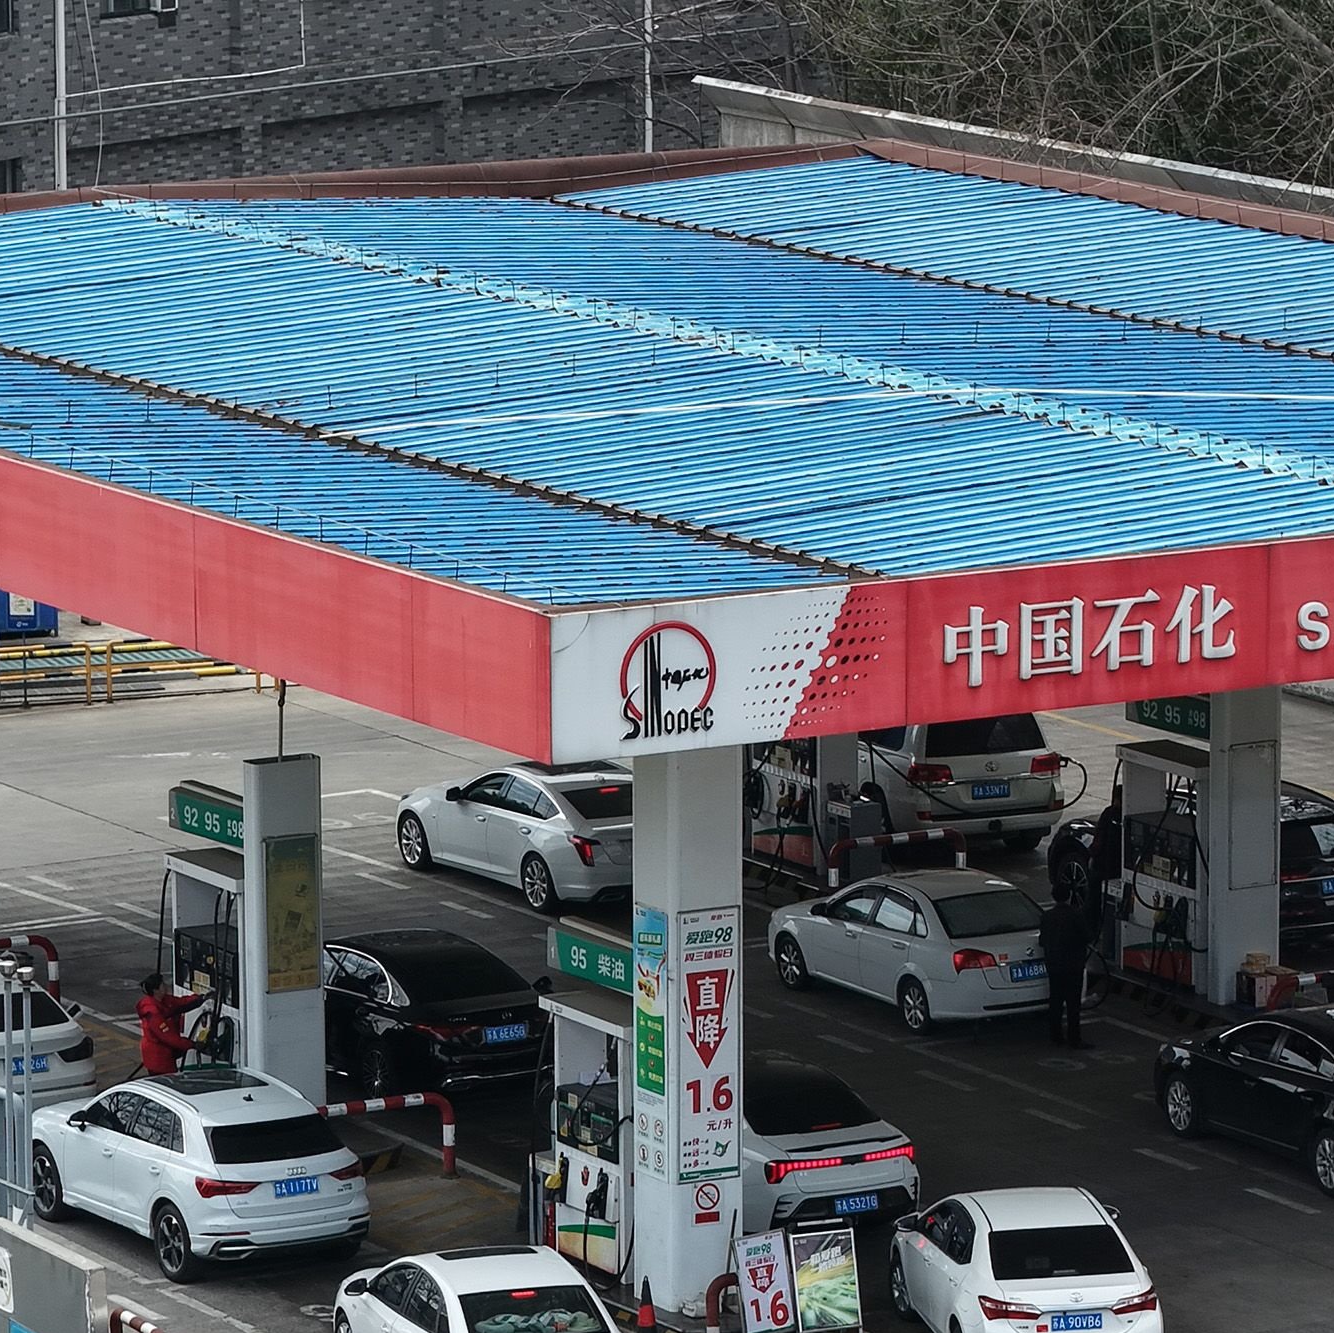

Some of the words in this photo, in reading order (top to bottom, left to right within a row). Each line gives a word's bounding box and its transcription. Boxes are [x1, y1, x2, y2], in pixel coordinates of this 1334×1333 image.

[943, 585, 1236, 689] 中国石化
[619, 631, 715, 741] SINOPEC
[1142, 700, 1158, 720] 92
[1164, 704, 1181, 725] 95
[1193, 710, 1207, 729] 98
[170, 807, 176, 820] 2
[183, 805, 199, 828] 92
[204, 811, 221, 833] 95
[232, 820, 244, 840] 98
[685, 926, 734, 946] 爱跑98
[550, 945, 555, 959] 1
[570, 945, 587, 970] 95
[597, 953, 625, 982] 柴油
[695, 975, 720, 1050] 直降
[686, 1075, 734, 1115] 1.6
[706, 1118, 734, 1133] 元/升
[750, 1289, 790, 1327] 1.6
